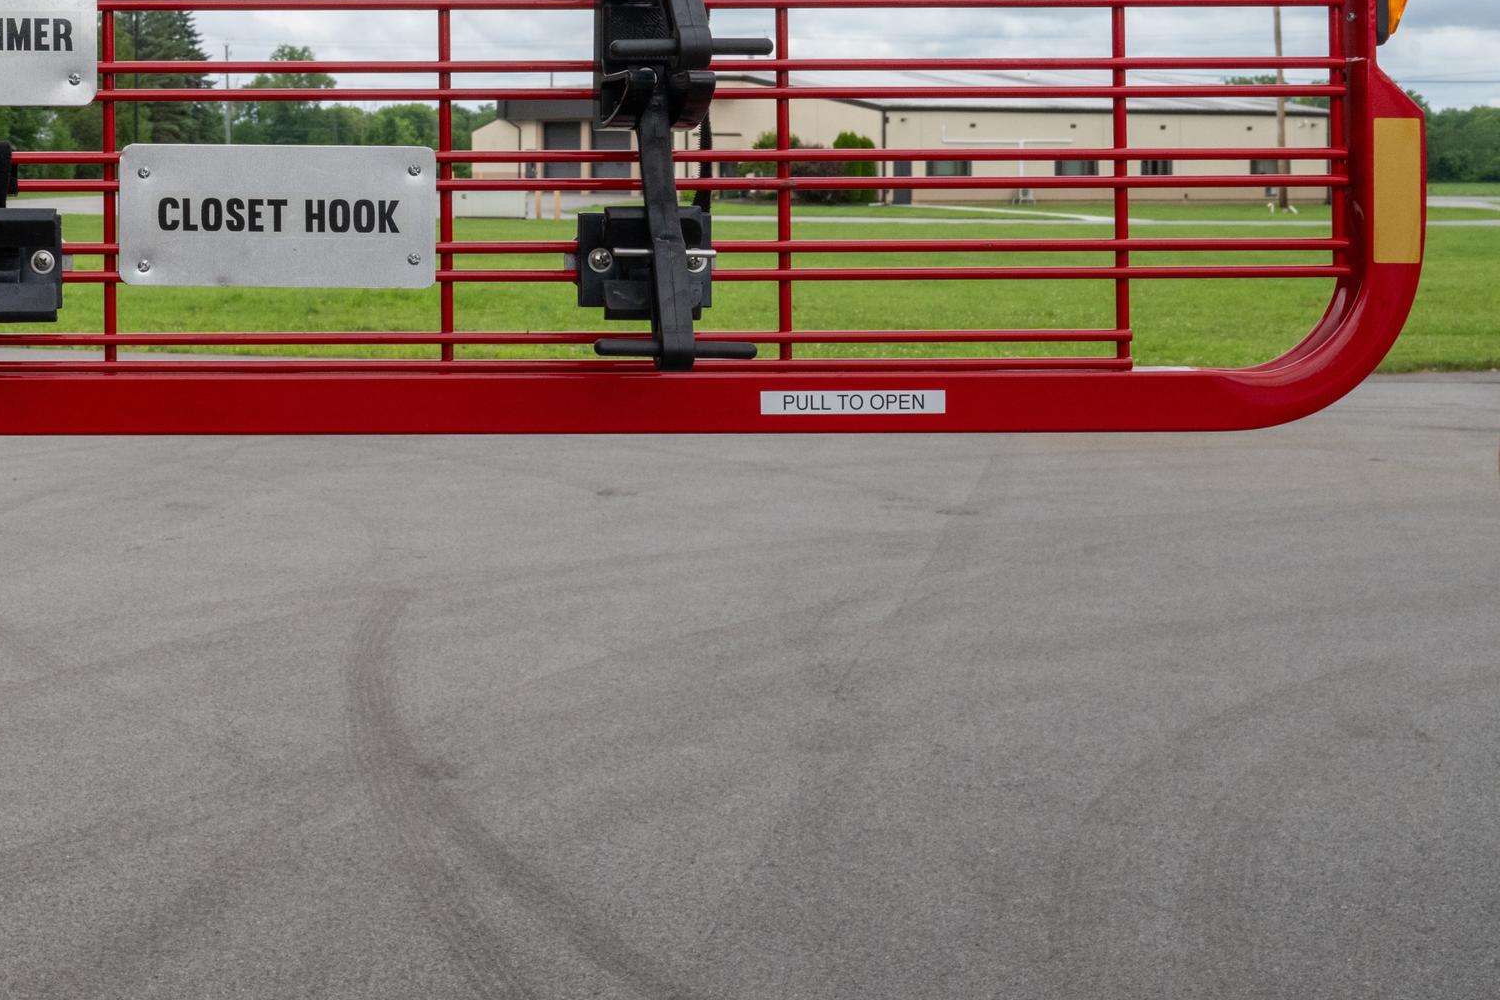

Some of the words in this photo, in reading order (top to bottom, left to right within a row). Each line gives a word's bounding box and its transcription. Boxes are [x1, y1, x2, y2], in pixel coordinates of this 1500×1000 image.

[157, 196, 288, 233] CLOSET
[304, 198, 401, 234] HOOK
[783, 394, 832, 411] PULL
[836, 394, 864, 411] TO
[869, 393, 925, 411] OPEN
